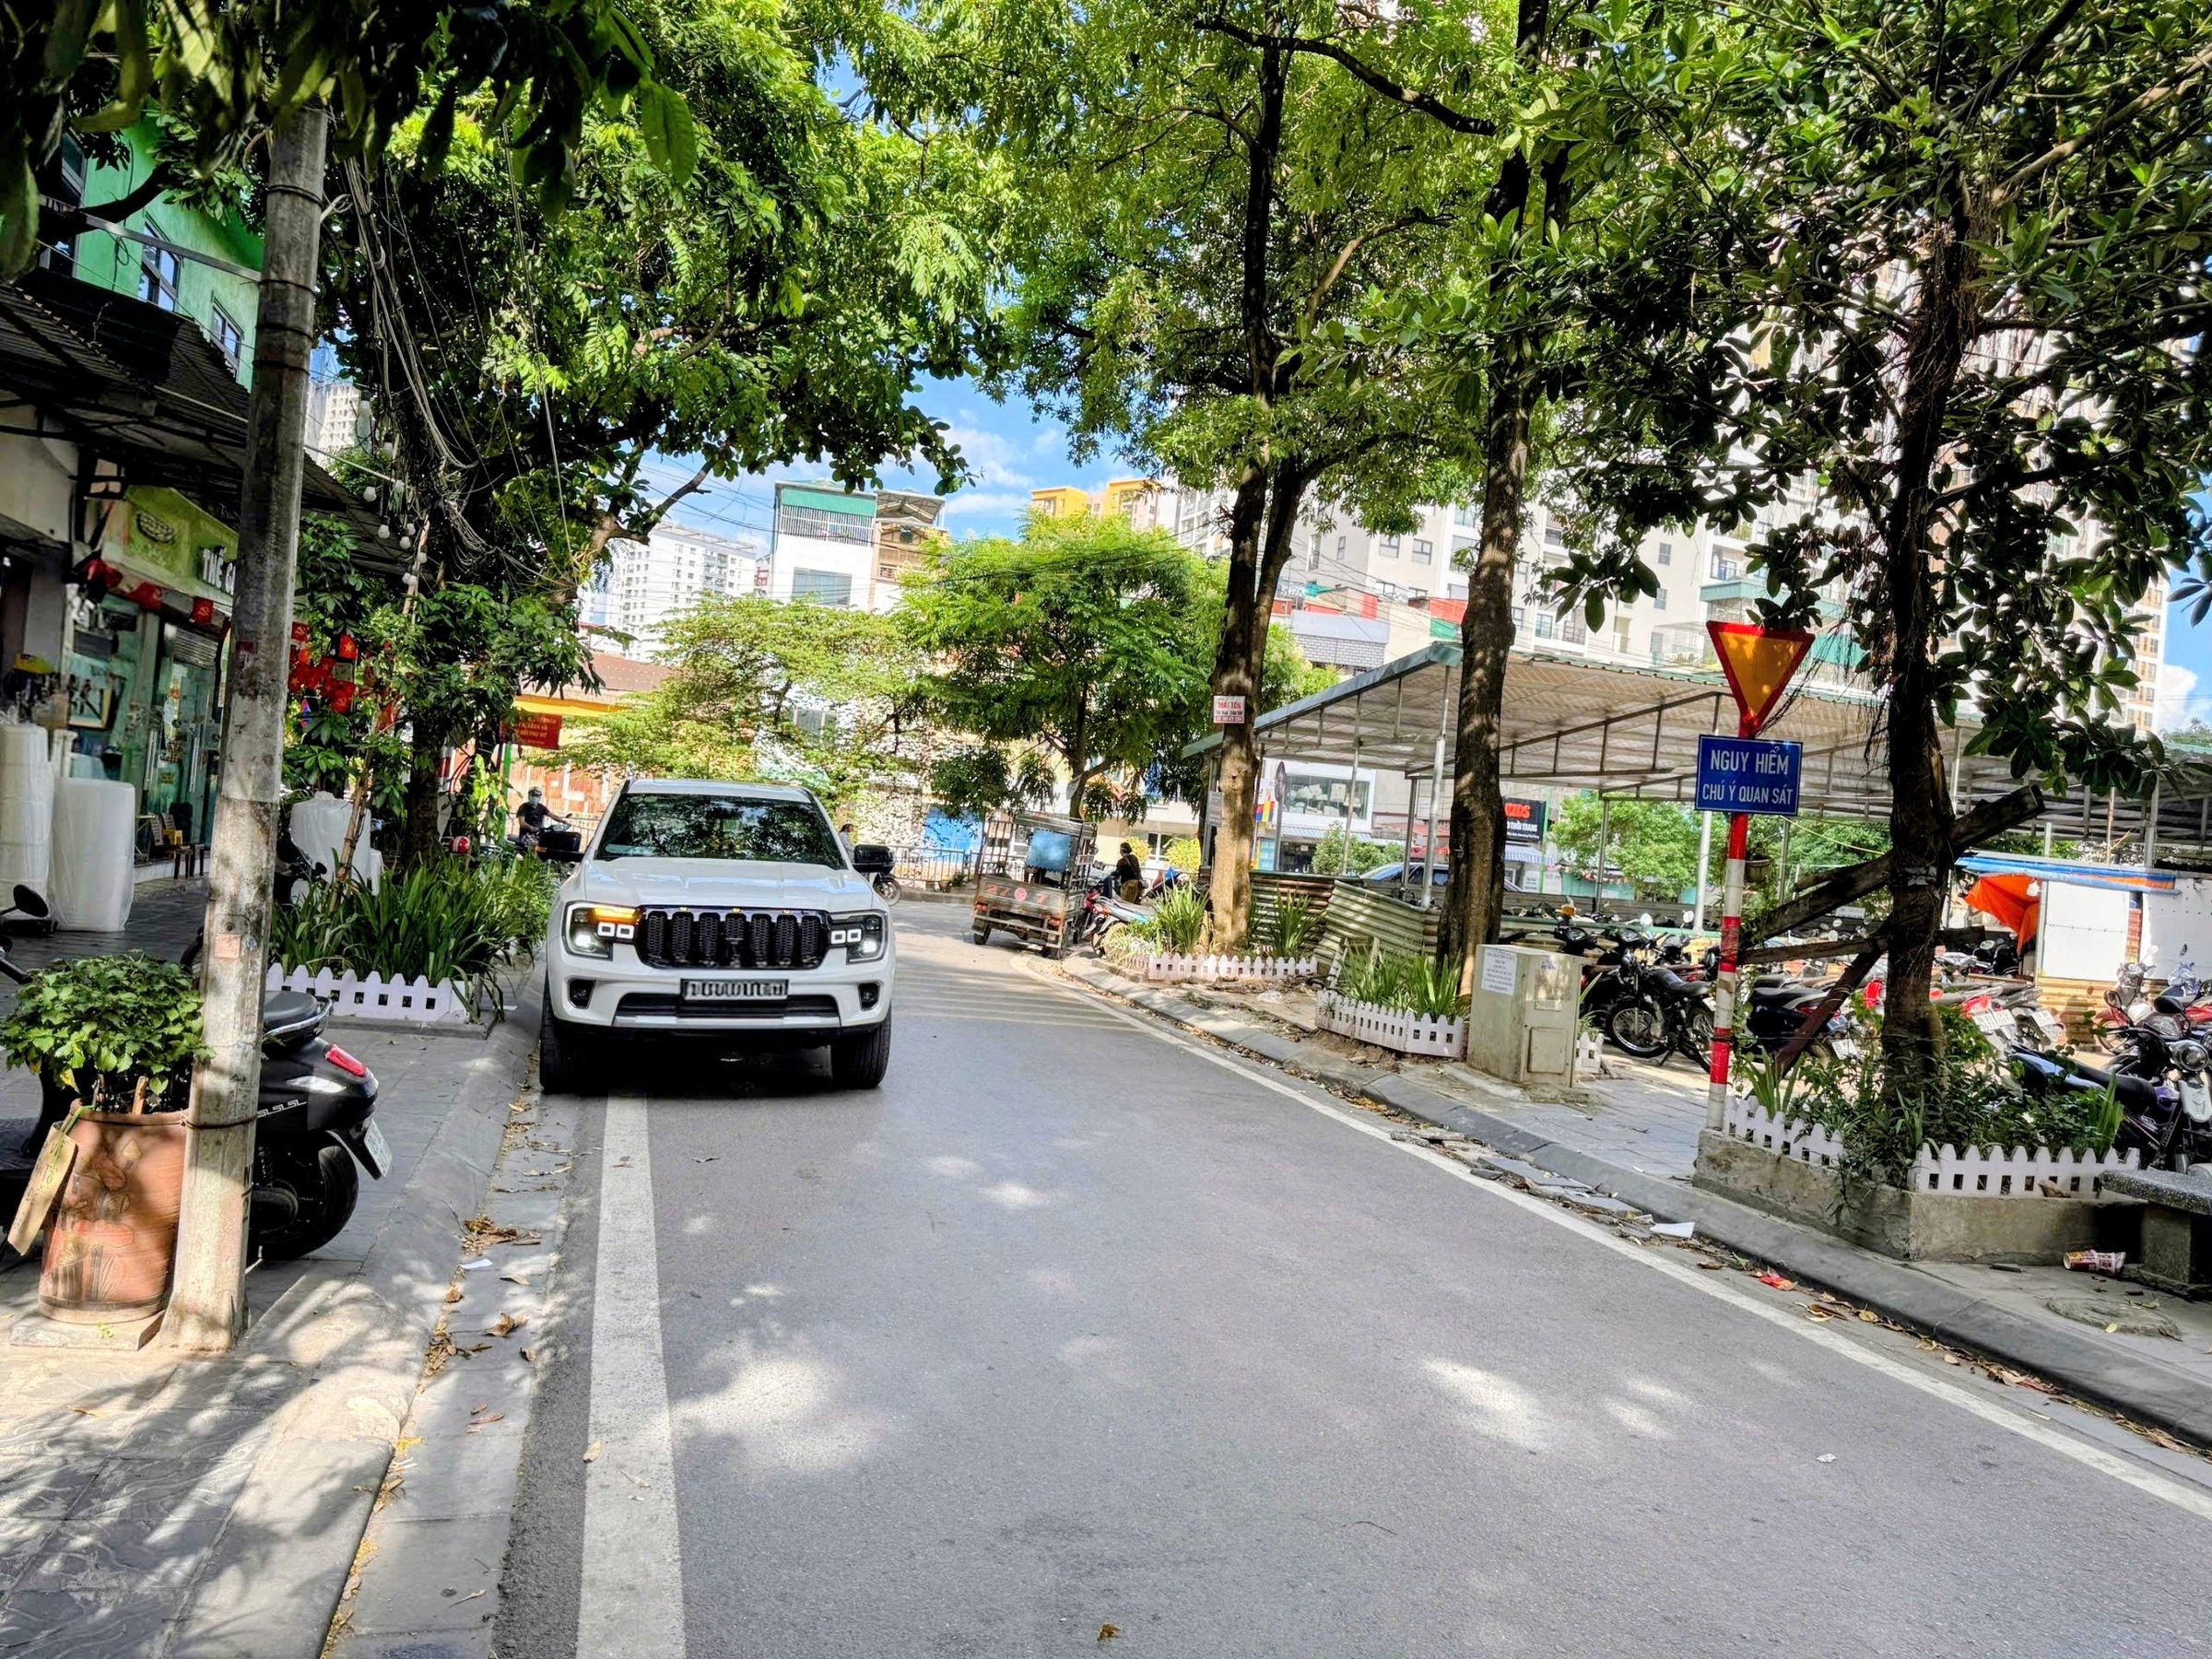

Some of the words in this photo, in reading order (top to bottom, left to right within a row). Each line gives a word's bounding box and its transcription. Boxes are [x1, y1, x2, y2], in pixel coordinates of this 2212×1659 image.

[1710, 749, 1749, 772] NGUY
[1755, 746, 1789, 775] HIỂM
[1702, 779, 1725, 801] CHÚ
[1728, 780, 1736, 801] Ý
[1738, 785, 1769, 804] QUAN
[1771, 783, 1794, 805] SÁT
